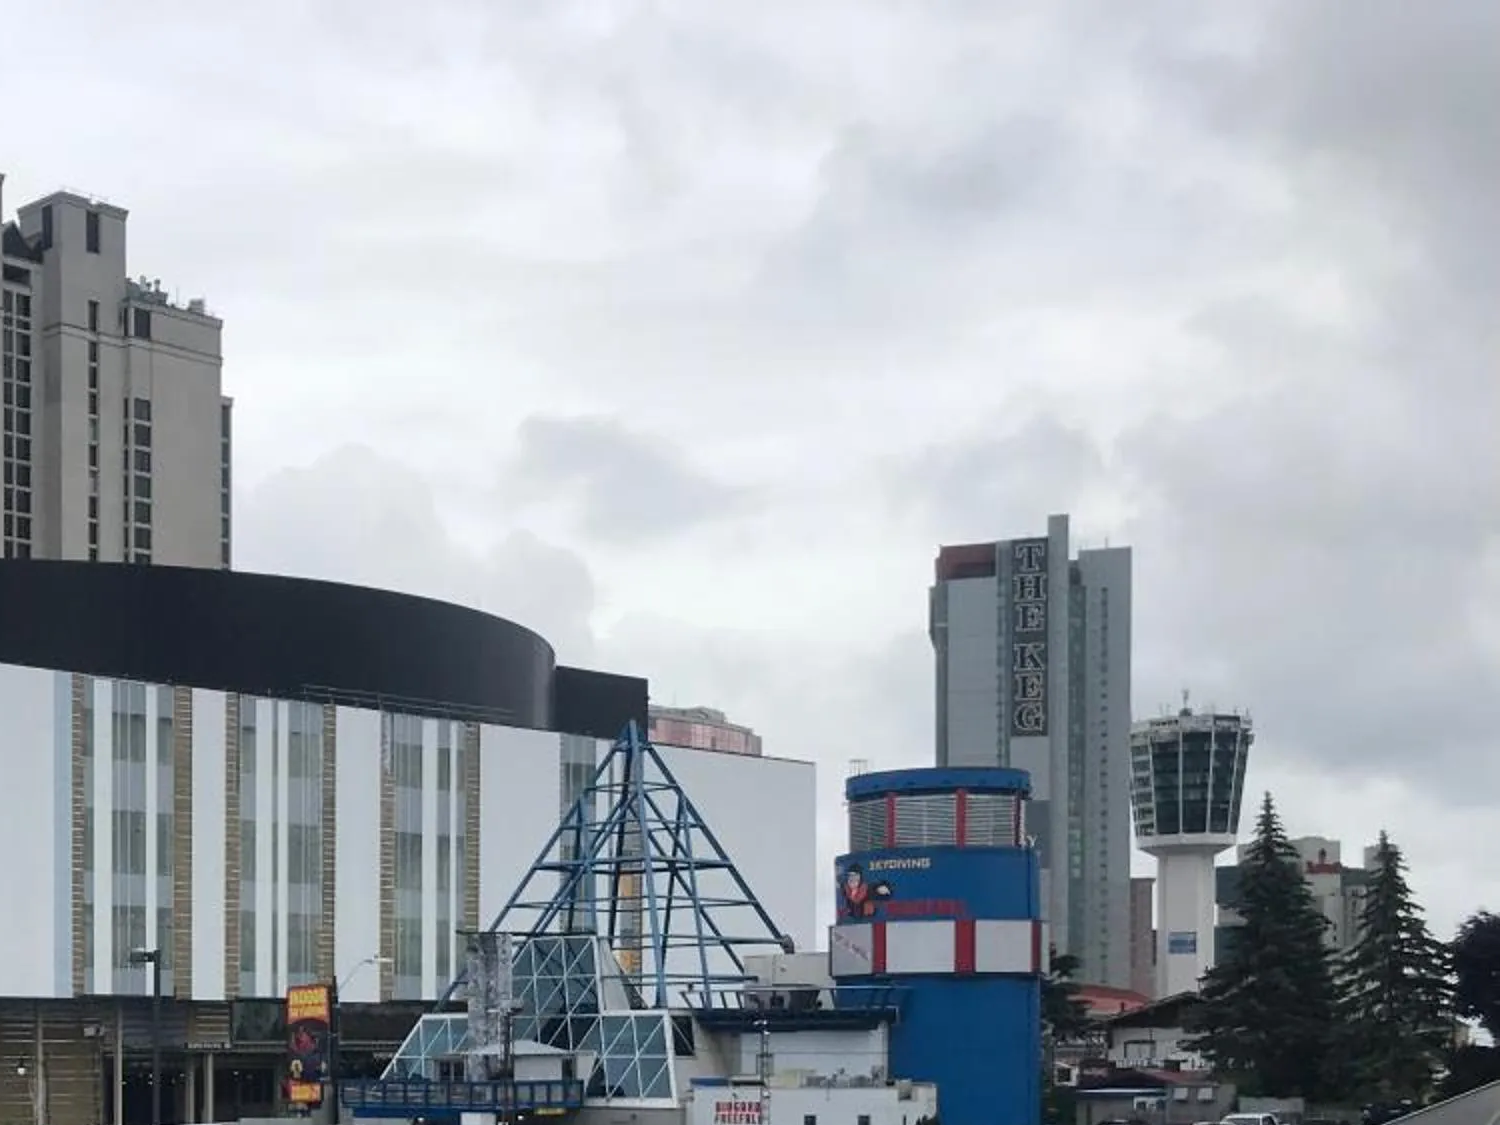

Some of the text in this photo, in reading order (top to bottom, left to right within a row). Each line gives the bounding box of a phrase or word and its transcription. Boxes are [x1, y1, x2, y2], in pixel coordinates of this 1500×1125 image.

[1014, 543, 1046, 731] THE KEG
[868, 857, 931, 871] SKYDIVING
